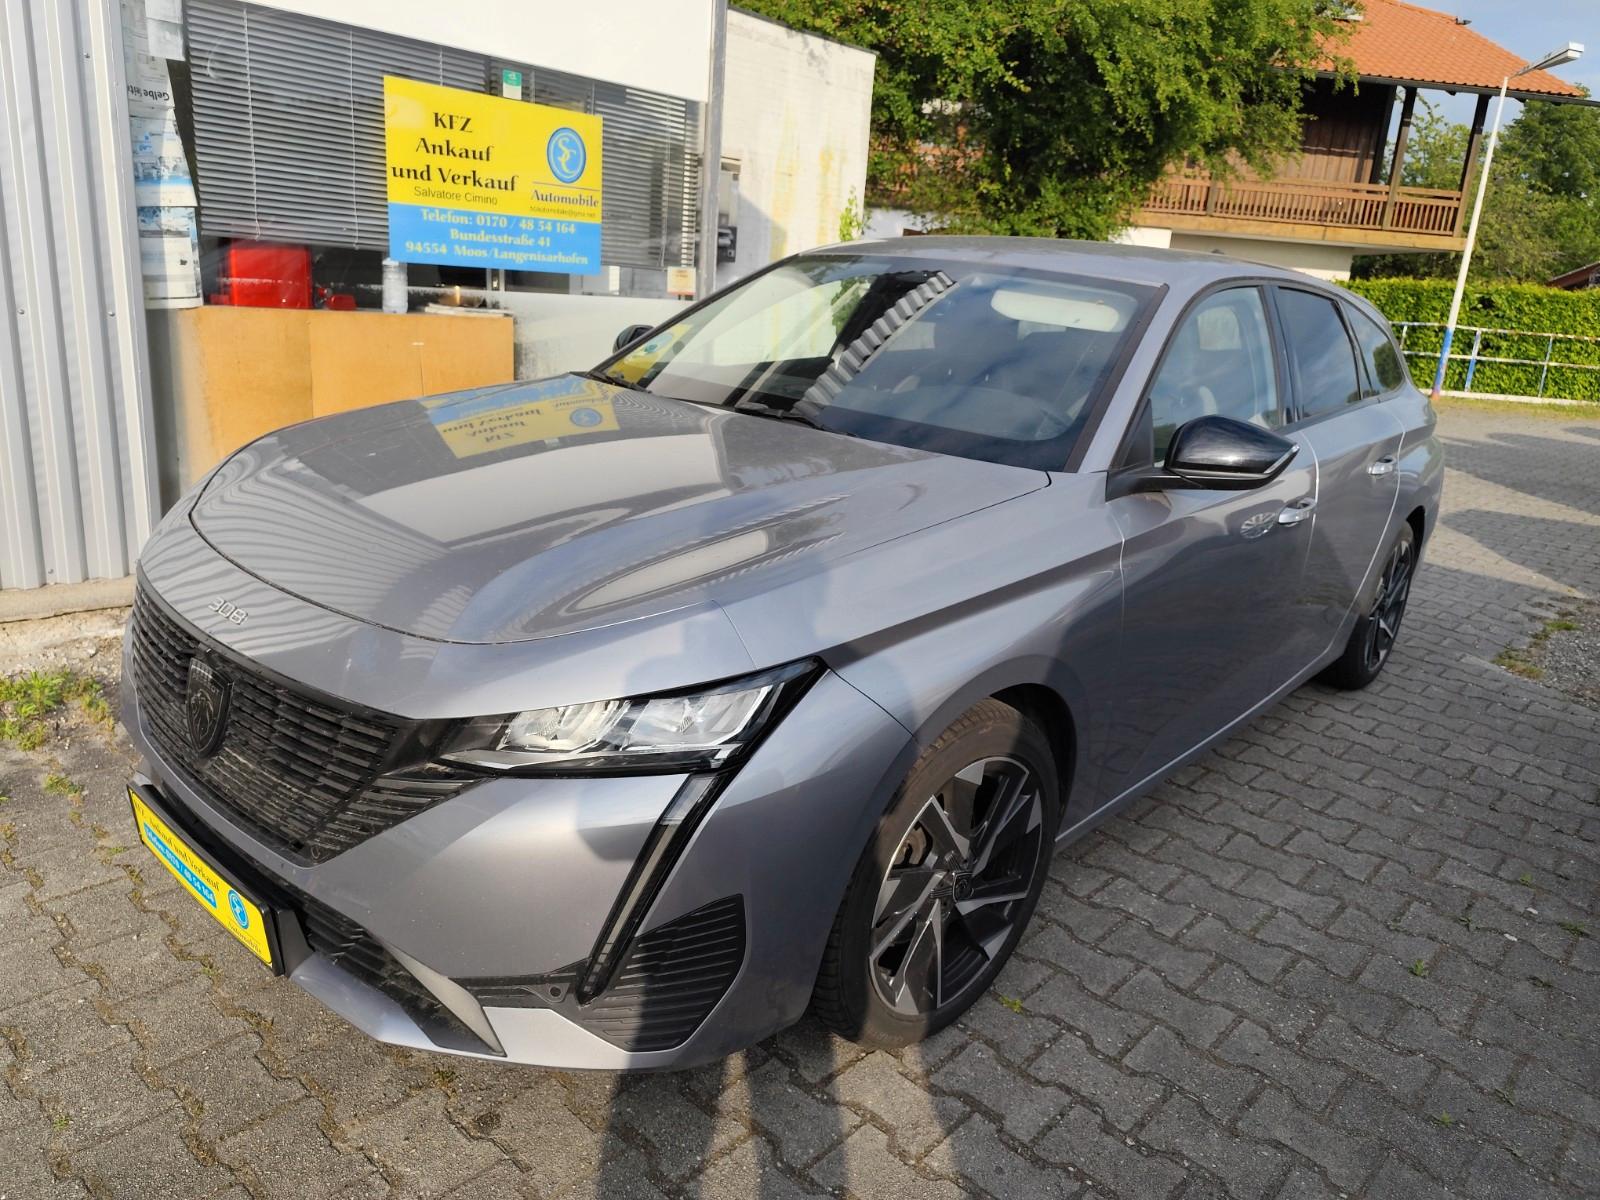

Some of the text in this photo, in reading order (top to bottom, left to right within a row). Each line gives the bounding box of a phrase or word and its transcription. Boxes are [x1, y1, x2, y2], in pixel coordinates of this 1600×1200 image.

[143, 89, 170, 101] Gelbe
[434, 112, 473, 133] KFZ
[416, 137, 494, 162] Ankauf
[391, 164, 519, 192] und Verkauf
[414, 185, 498, 205] Salvatore Cimino
[531, 189, 600, 208] Automobile
[420, 208, 474, 225] Telefon:
[476, 215, 508, 229] 0170
[518, 218, 535, 231] 48
[537, 221, 553, 233] 54
[556, 222, 577, 235] 164
[405, 240, 447, 255] 94554
[450, 228, 551, 247] Bundesstraße 41
[208, 598, 248, 625] 308
